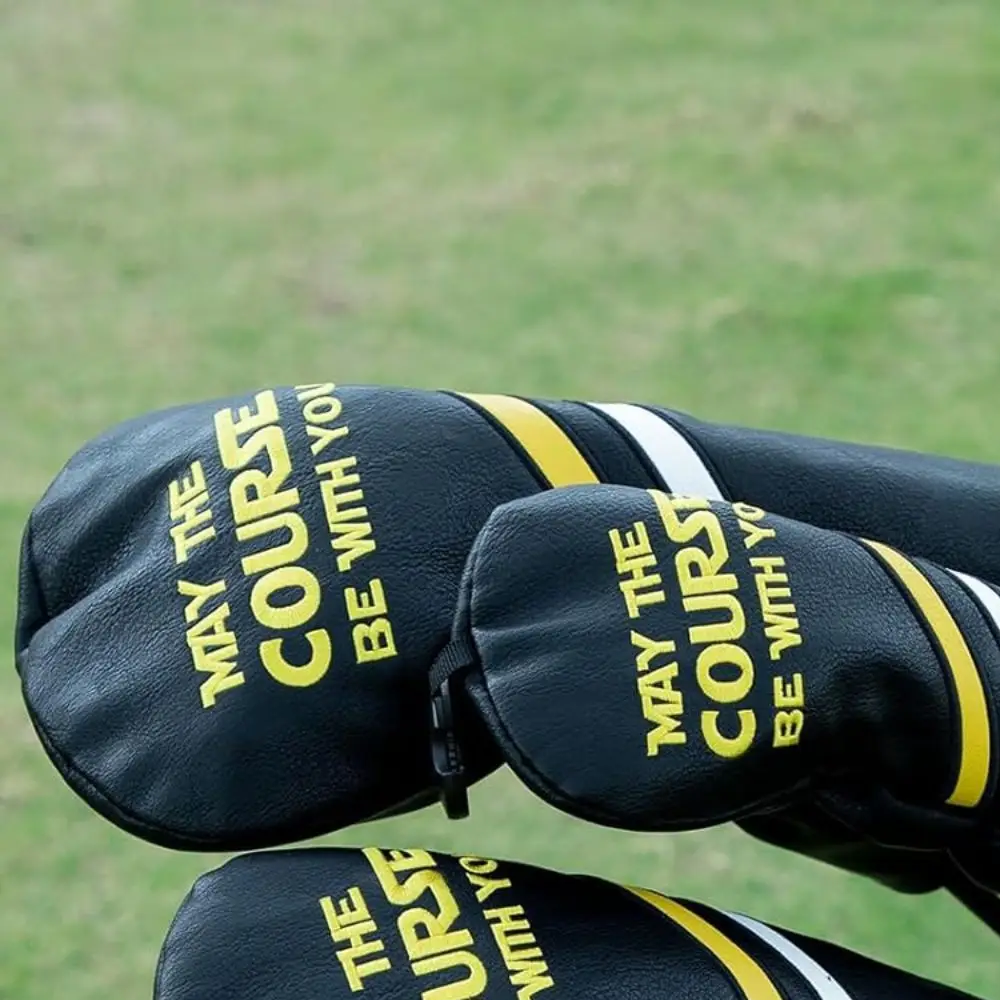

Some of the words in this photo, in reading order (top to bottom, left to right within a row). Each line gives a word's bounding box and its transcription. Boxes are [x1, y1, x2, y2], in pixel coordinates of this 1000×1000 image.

[168, 460, 216, 563] THE
[213, 389, 332, 687] COURSE
[315, 456, 376, 571] WITH
[732, 502, 776, 549] YO
[345, 578, 398, 664] BE
[608, 521, 666, 618] THE
[749, 556, 802, 660] WITH
[178, 579, 245, 708] MAY
[629, 631, 687, 757] MAY
[773, 673, 804, 748] BE
[459, 856, 512, 902] YO
[319, 886, 391, 992] THE
